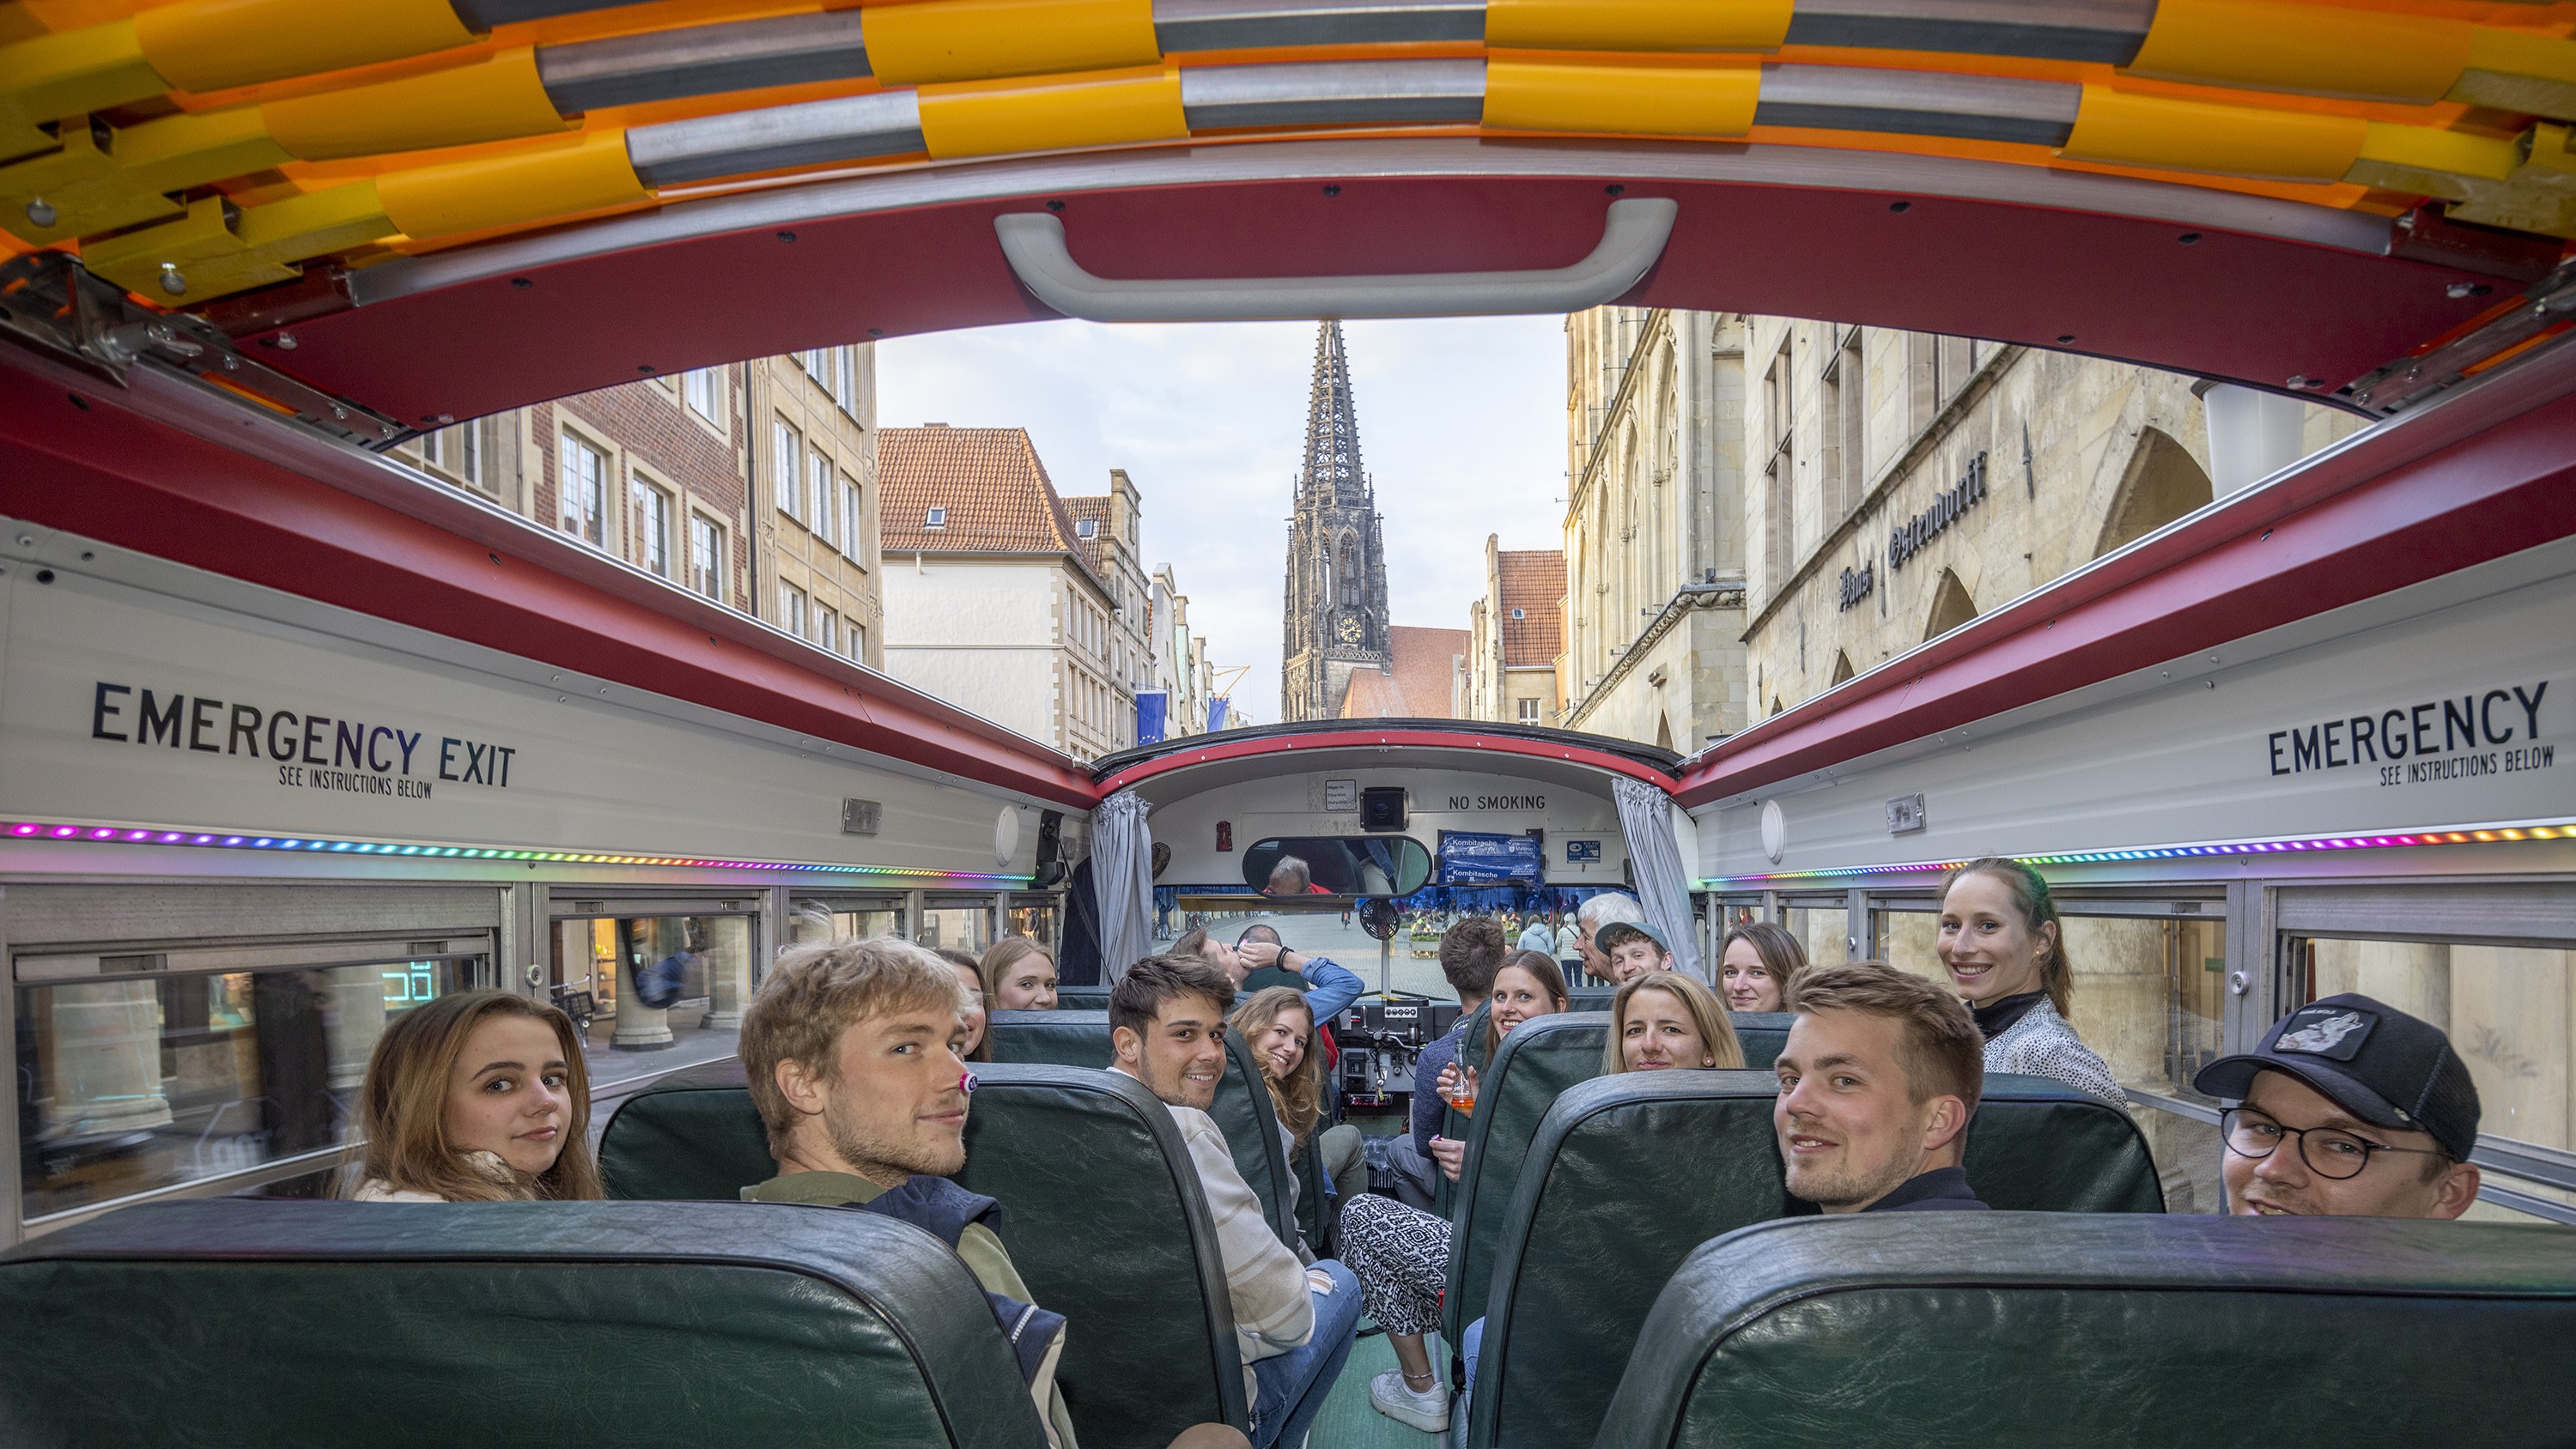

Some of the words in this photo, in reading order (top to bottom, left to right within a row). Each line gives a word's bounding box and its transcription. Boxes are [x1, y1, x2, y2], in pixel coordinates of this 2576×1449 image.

[1889, 451, 1988, 569] Ostendorff
[92, 681, 422, 775] EMERGENCY
[439, 737, 516, 788] EXIT
[2269, 680, 2549, 776] EMERGENCY
[278, 765, 304, 787] SEE
[309, 769, 392, 797] INSTRUCTIONS
[398, 779, 433, 800] BELOW
[2380, 765, 2402, 787] SEE
[2407, 752, 2498, 784] INSTRUCTIONS
[2505, 744, 2555, 773] BELOW
[1449, 796, 1469, 809] NO
[1477, 795, 1546, 809] SMOKING
[1452, 839, 1498, 847] Kombitasche
[1452, 869, 1498, 878] Kombitasche
